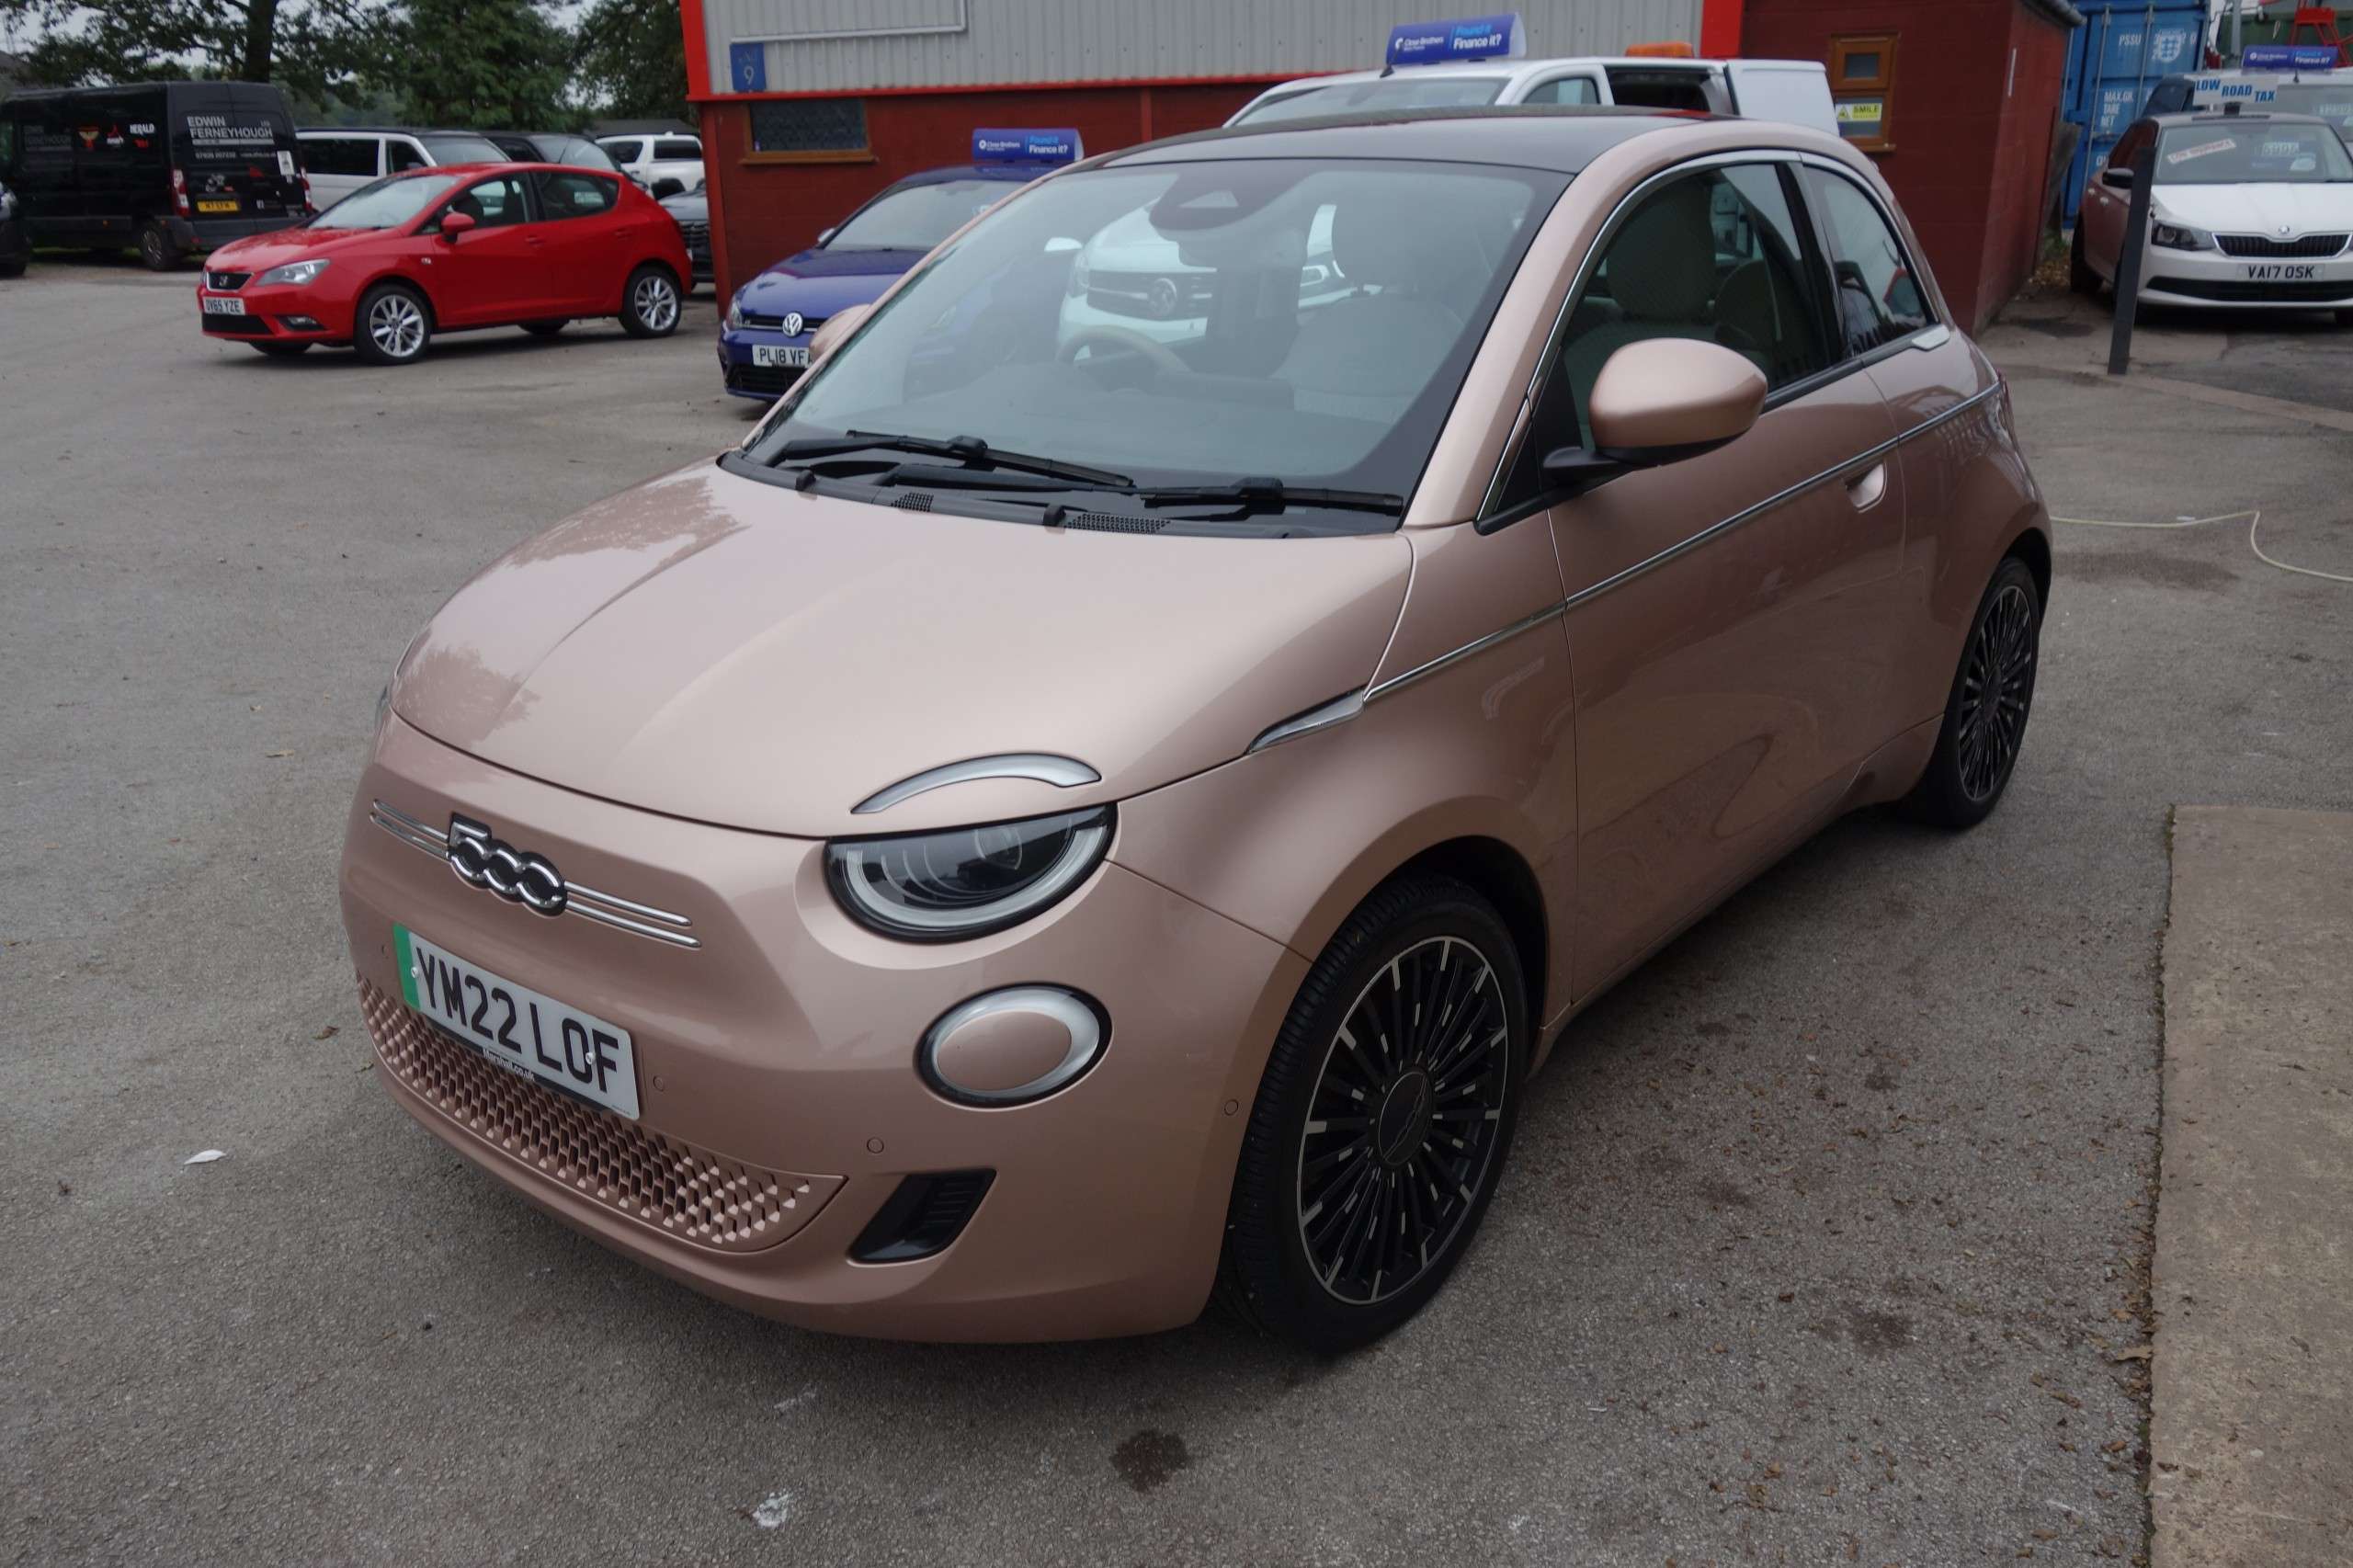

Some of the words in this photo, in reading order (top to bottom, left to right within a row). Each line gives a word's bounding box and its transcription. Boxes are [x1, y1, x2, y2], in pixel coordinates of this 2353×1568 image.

[1453, 38, 1487, 50] Finance
[1489, 34, 1502, 46] it?
[2119, 33, 2142, 45] PSSU
[744, 65, 754, 85] 9
[2196, 79, 2221, 91] LOW
[2222, 85, 2252, 97] ROAD
[2255, 90, 2276, 102] TAX
[187, 116, 226, 127] EDWIN
[130, 123, 154, 135] HERALD
[189, 127, 273, 139] FERNEYHOUGH
[1029, 144, 1057, 154] Finance
[1058, 144, 1068, 154] it?
[2248, 264, 2281, 278] VA17
[2285, 265, 2314, 278] OSK
[223, 300, 241, 312] YZE
[759, 347, 786, 364] PL18
[449, 813, 566, 915] 500
[416, 947, 522, 1054] YM22
[529, 1002, 619, 1094] LOF
